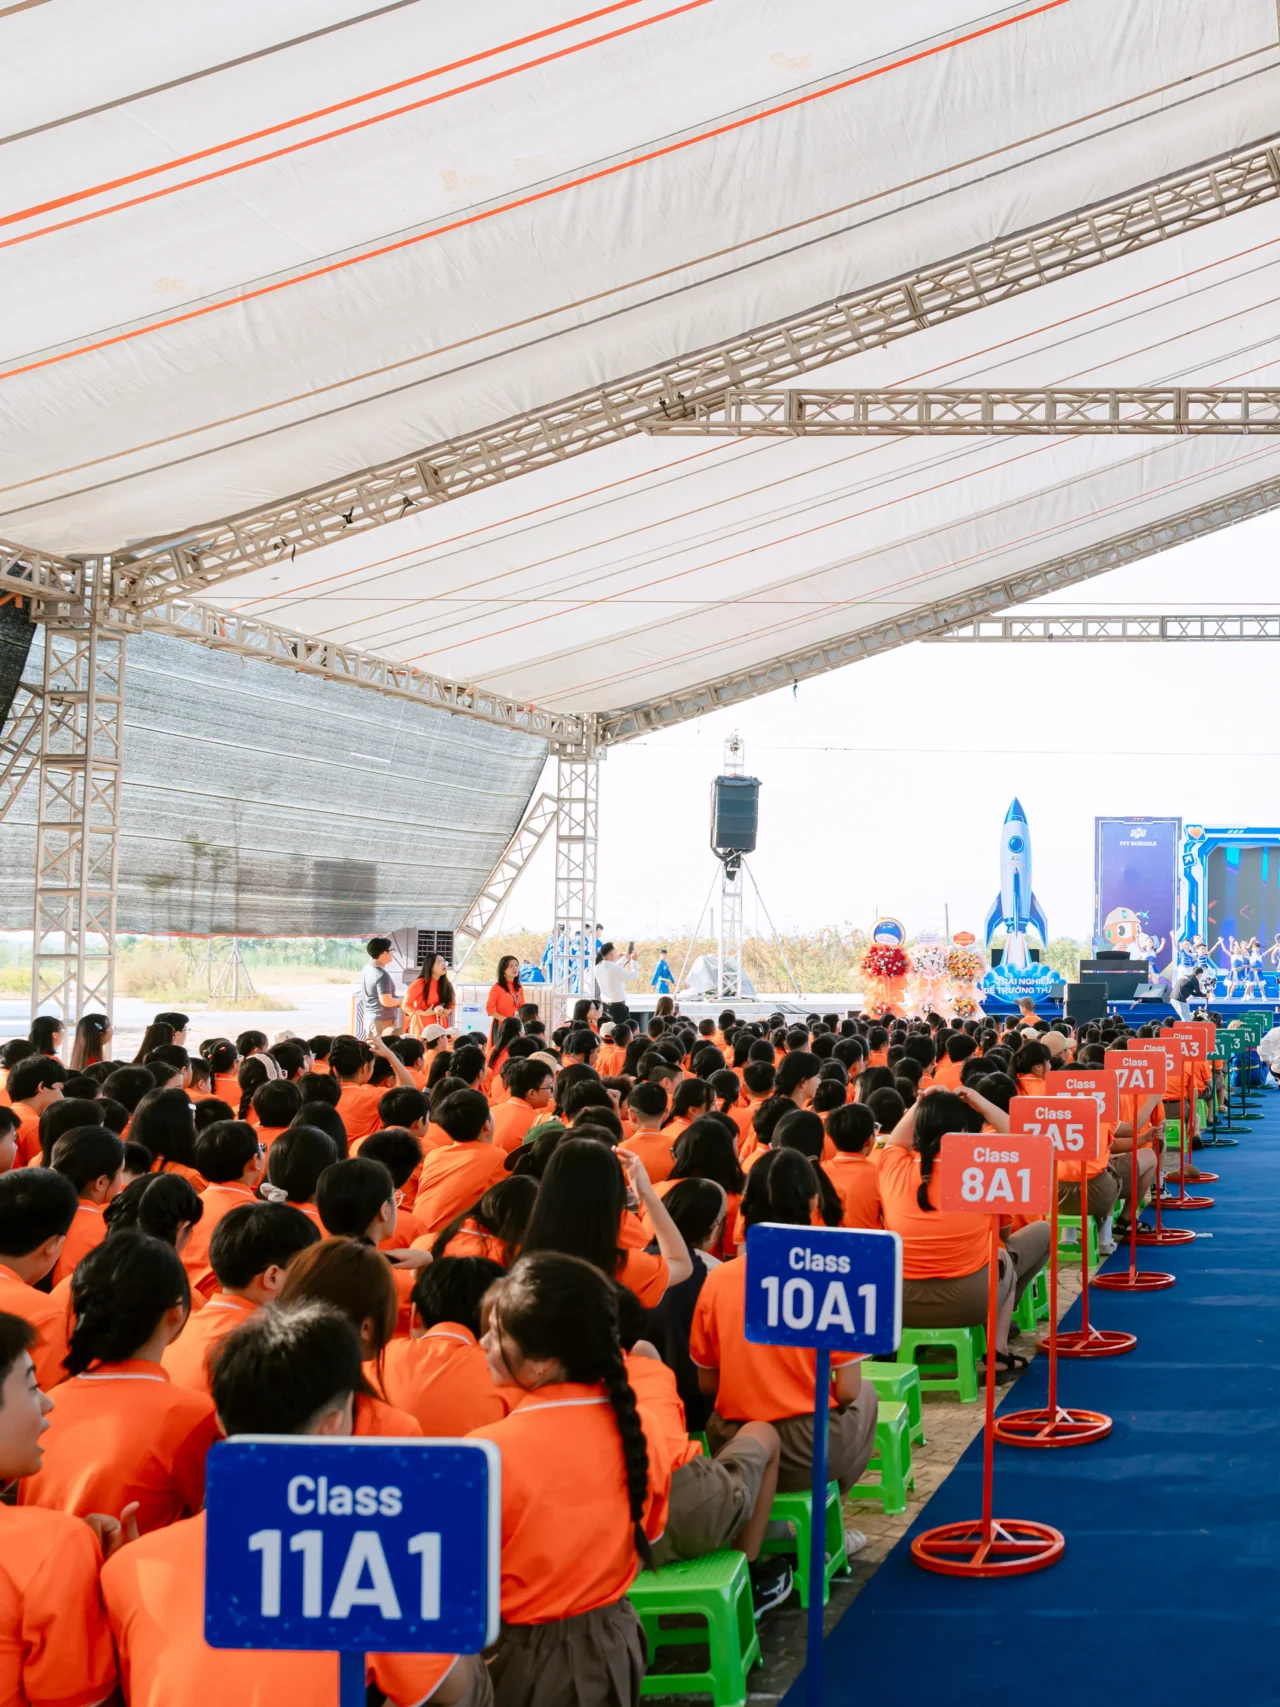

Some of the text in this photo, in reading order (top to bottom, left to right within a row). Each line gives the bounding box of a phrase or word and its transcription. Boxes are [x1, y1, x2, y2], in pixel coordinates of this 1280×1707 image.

[1122, 1058, 1148, 1067] Class
[1066, 1079, 1096, 1090] Class
[1119, 1069, 1154, 1088] 7A1
[1035, 1107, 1072, 1120] Class
[973, 1147, 1020, 1163] Class
[961, 1167, 1031, 1203] 8A1
[788, 1246, 851, 1274] Class
[760, 1275, 877, 1336] 10A1
[286, 1474, 403, 1517] Class
[248, 1528, 442, 1621] 11A1
